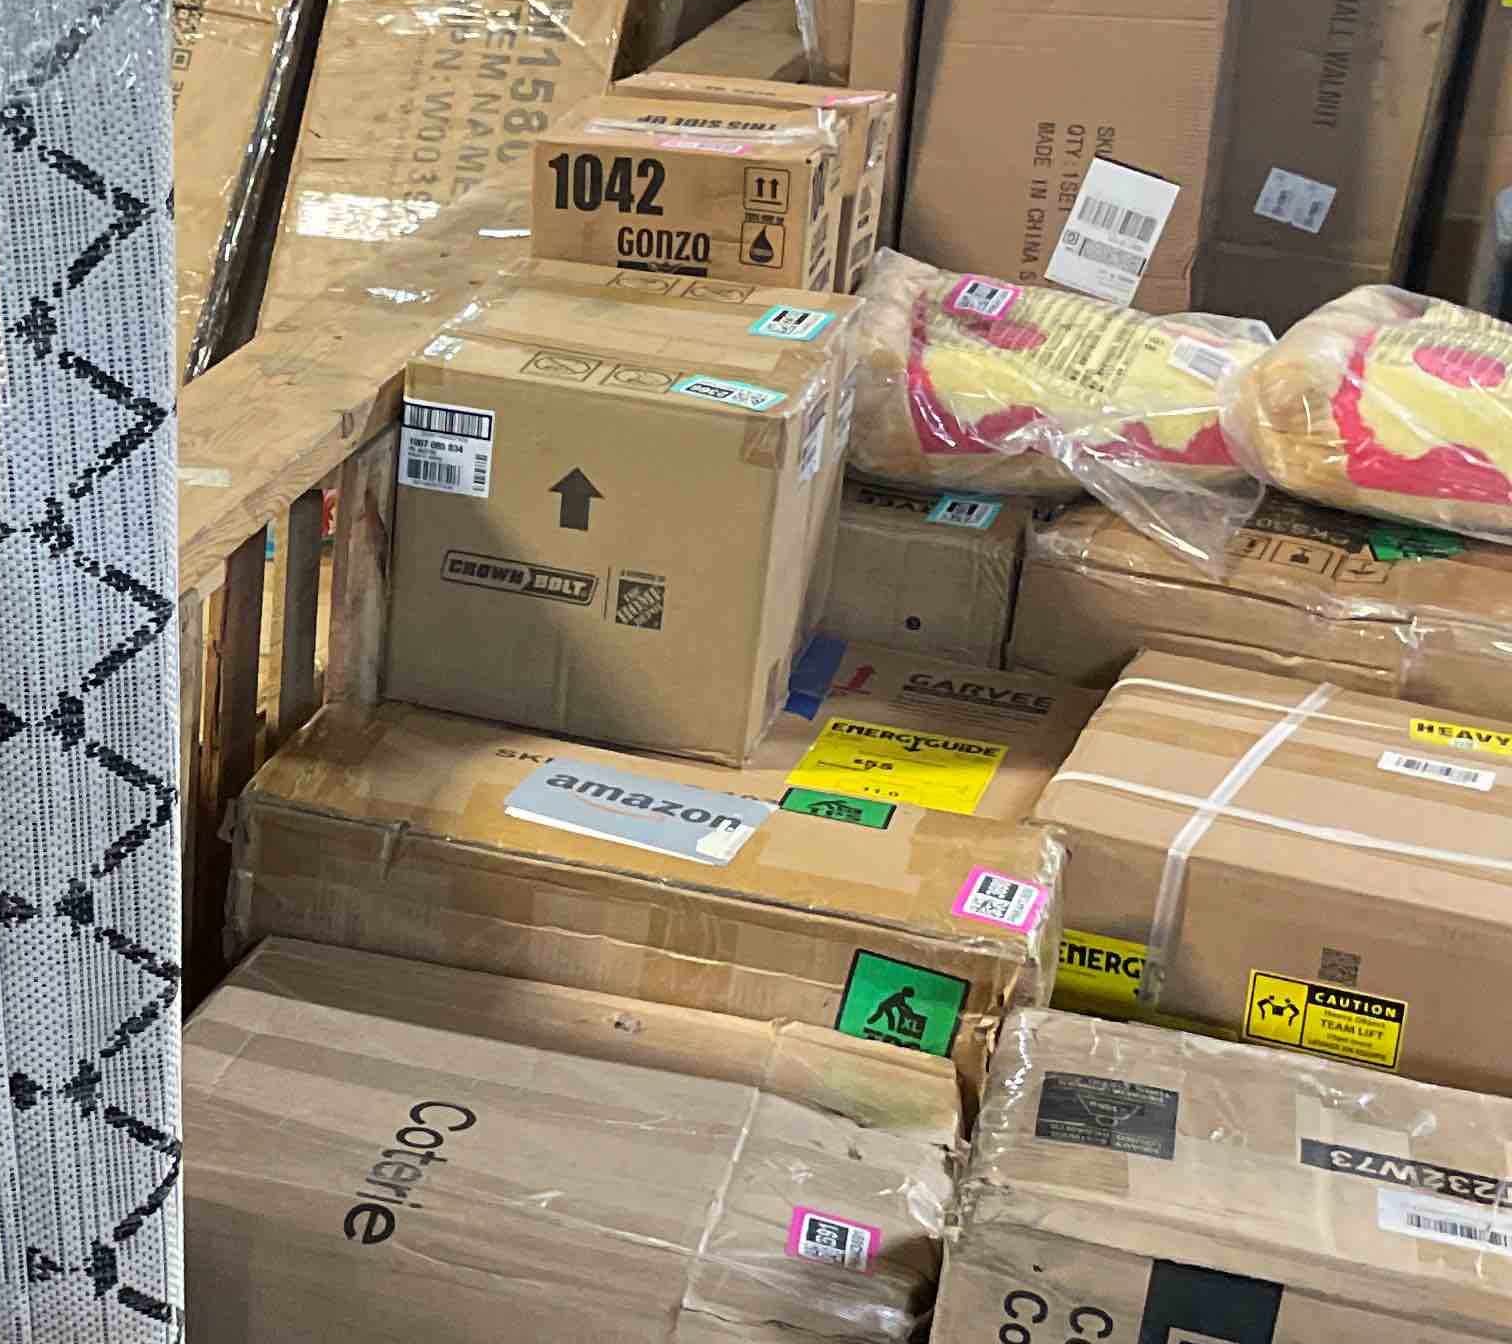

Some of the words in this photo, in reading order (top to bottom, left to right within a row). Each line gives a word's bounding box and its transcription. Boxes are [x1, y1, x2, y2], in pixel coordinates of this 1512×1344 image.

[636, 114, 668, 125] UP
[675, 117, 722, 129] SIDE
[1033, 121, 1055, 168] MADE
[548, 151, 667, 218] 1042
[1031, 178, 1049, 200] IN
[1022, 206, 1045, 267] CHINA
[446, 558, 523, 590] CROWN
[531, 573, 590, 601] BOLT
[1415, 720, 1510, 749] HEAVY
[545, 769, 742, 834] amazon
[1313, 990, 1400, 1020] CAUTION
[1319, 1017, 1355, 1038] TEAM
[1356, 1024, 1386, 1042] LIFT
[342, 1099, 478, 1246] Coterie
